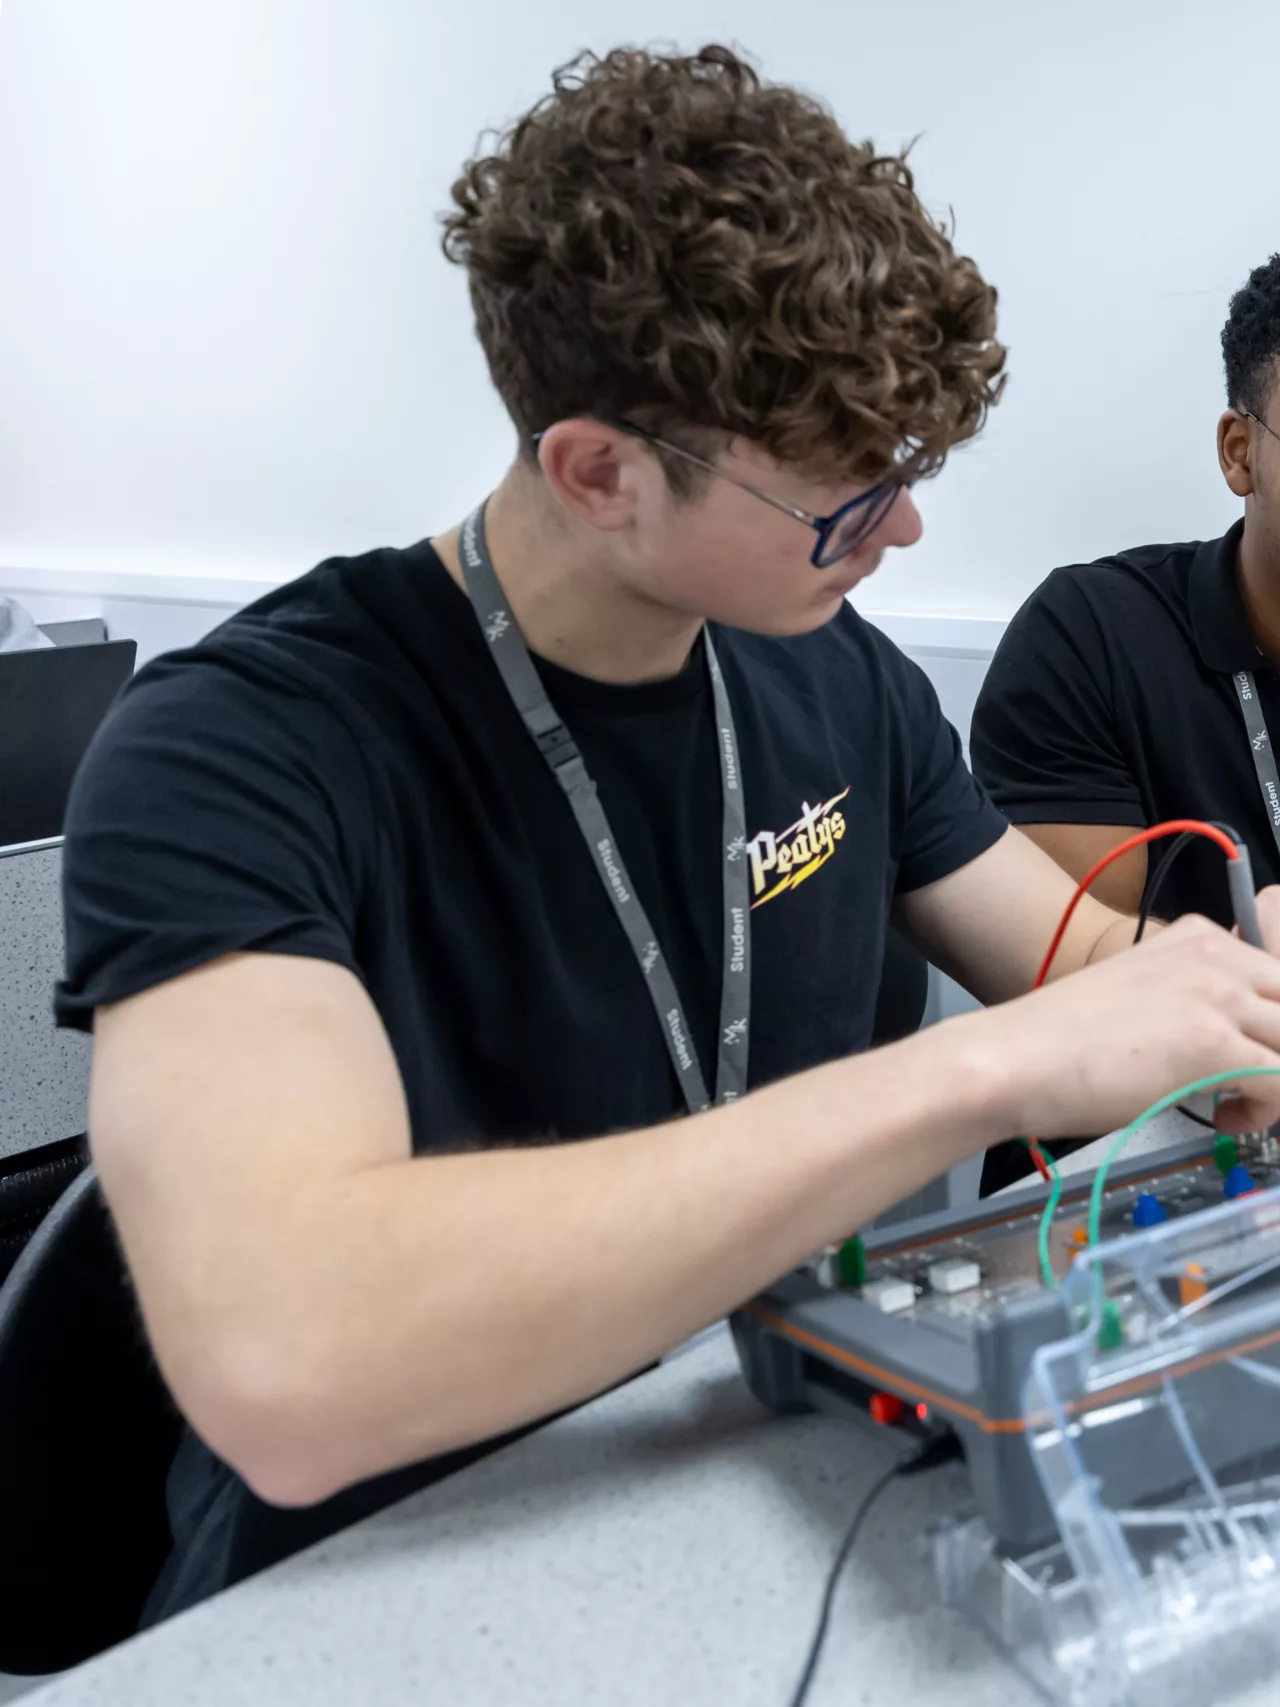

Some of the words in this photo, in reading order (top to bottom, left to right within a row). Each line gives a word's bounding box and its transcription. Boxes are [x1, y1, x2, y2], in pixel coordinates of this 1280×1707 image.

[1237, 671, 1252, 700] Stud
[720, 727, 738, 790] Student
[597, 839, 631, 903] Student
[730, 907, 745, 972] Student
[666, 1008, 692, 1070] Student
